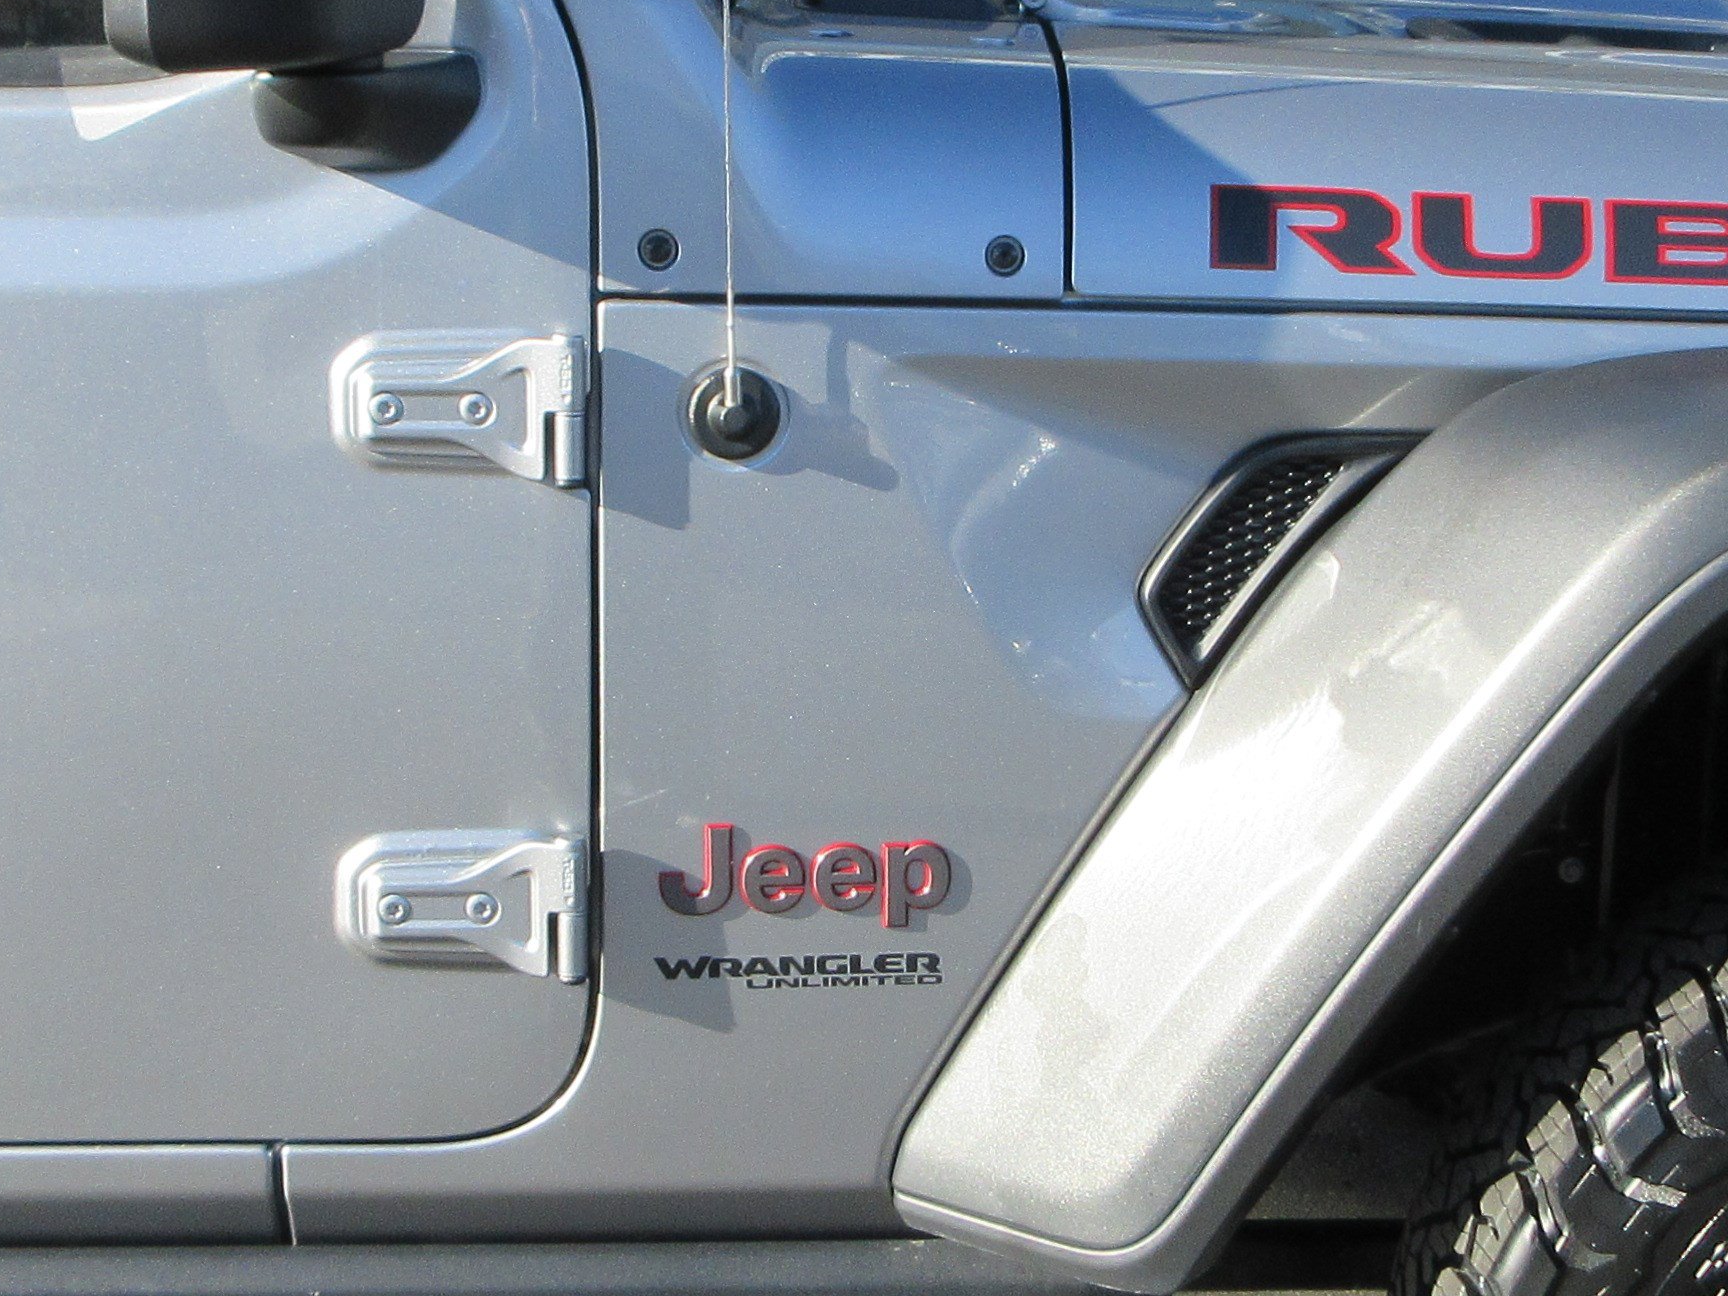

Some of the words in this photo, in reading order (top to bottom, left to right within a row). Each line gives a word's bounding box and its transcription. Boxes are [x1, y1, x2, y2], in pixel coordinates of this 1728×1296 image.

[658, 822, 952, 929] Jeep
[653, 952, 942, 981] WRANGLER
[746, 974, 944, 990] UNLIMITED
